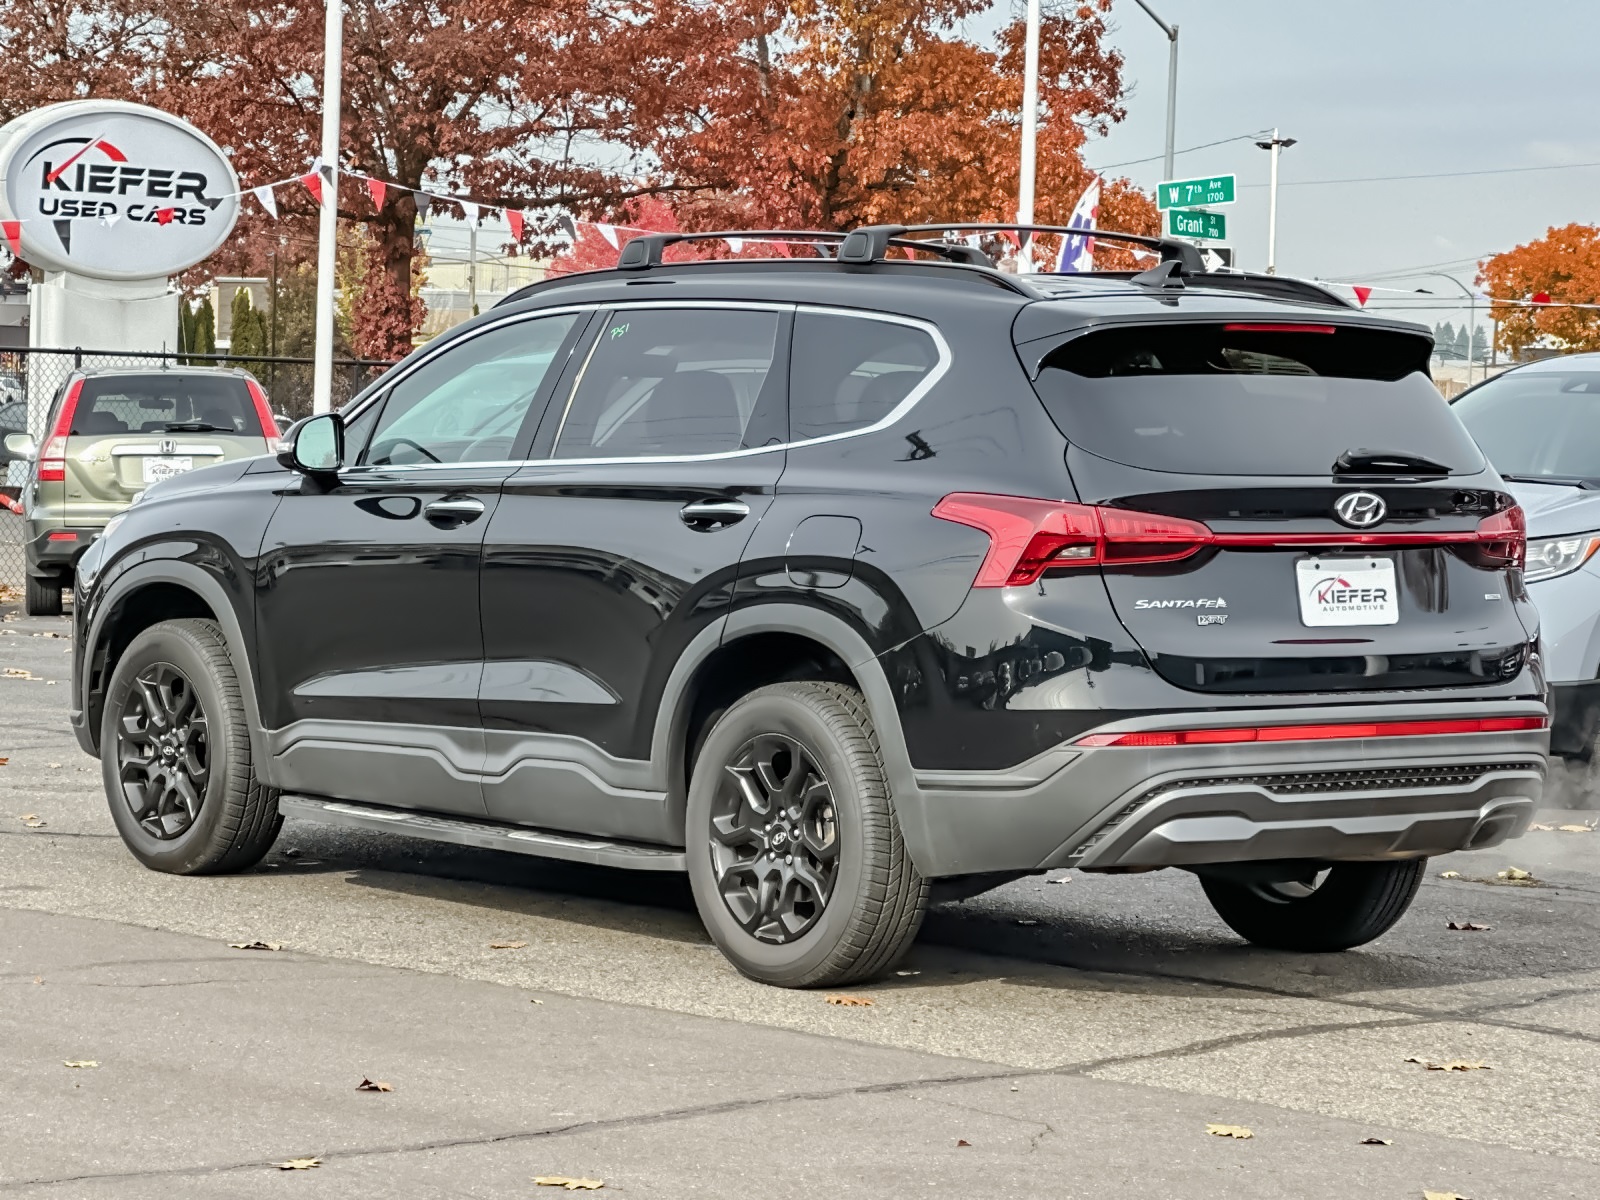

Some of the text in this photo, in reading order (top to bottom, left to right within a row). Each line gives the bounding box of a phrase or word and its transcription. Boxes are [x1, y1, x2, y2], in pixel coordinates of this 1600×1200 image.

[41, 160, 209, 203] KIEFER
[1168, 180, 1222, 204] W 7th Ave
[1207, 191, 1224, 203] 1700
[39, 197, 207, 226] USED CARS
[1176, 214, 1216, 234] Grant St
[1208, 227, 1219, 237] 700
[1318, 588, 1388, 604] KIEFER
[1322, 604, 1385, 612] AUTOMOTIVE
